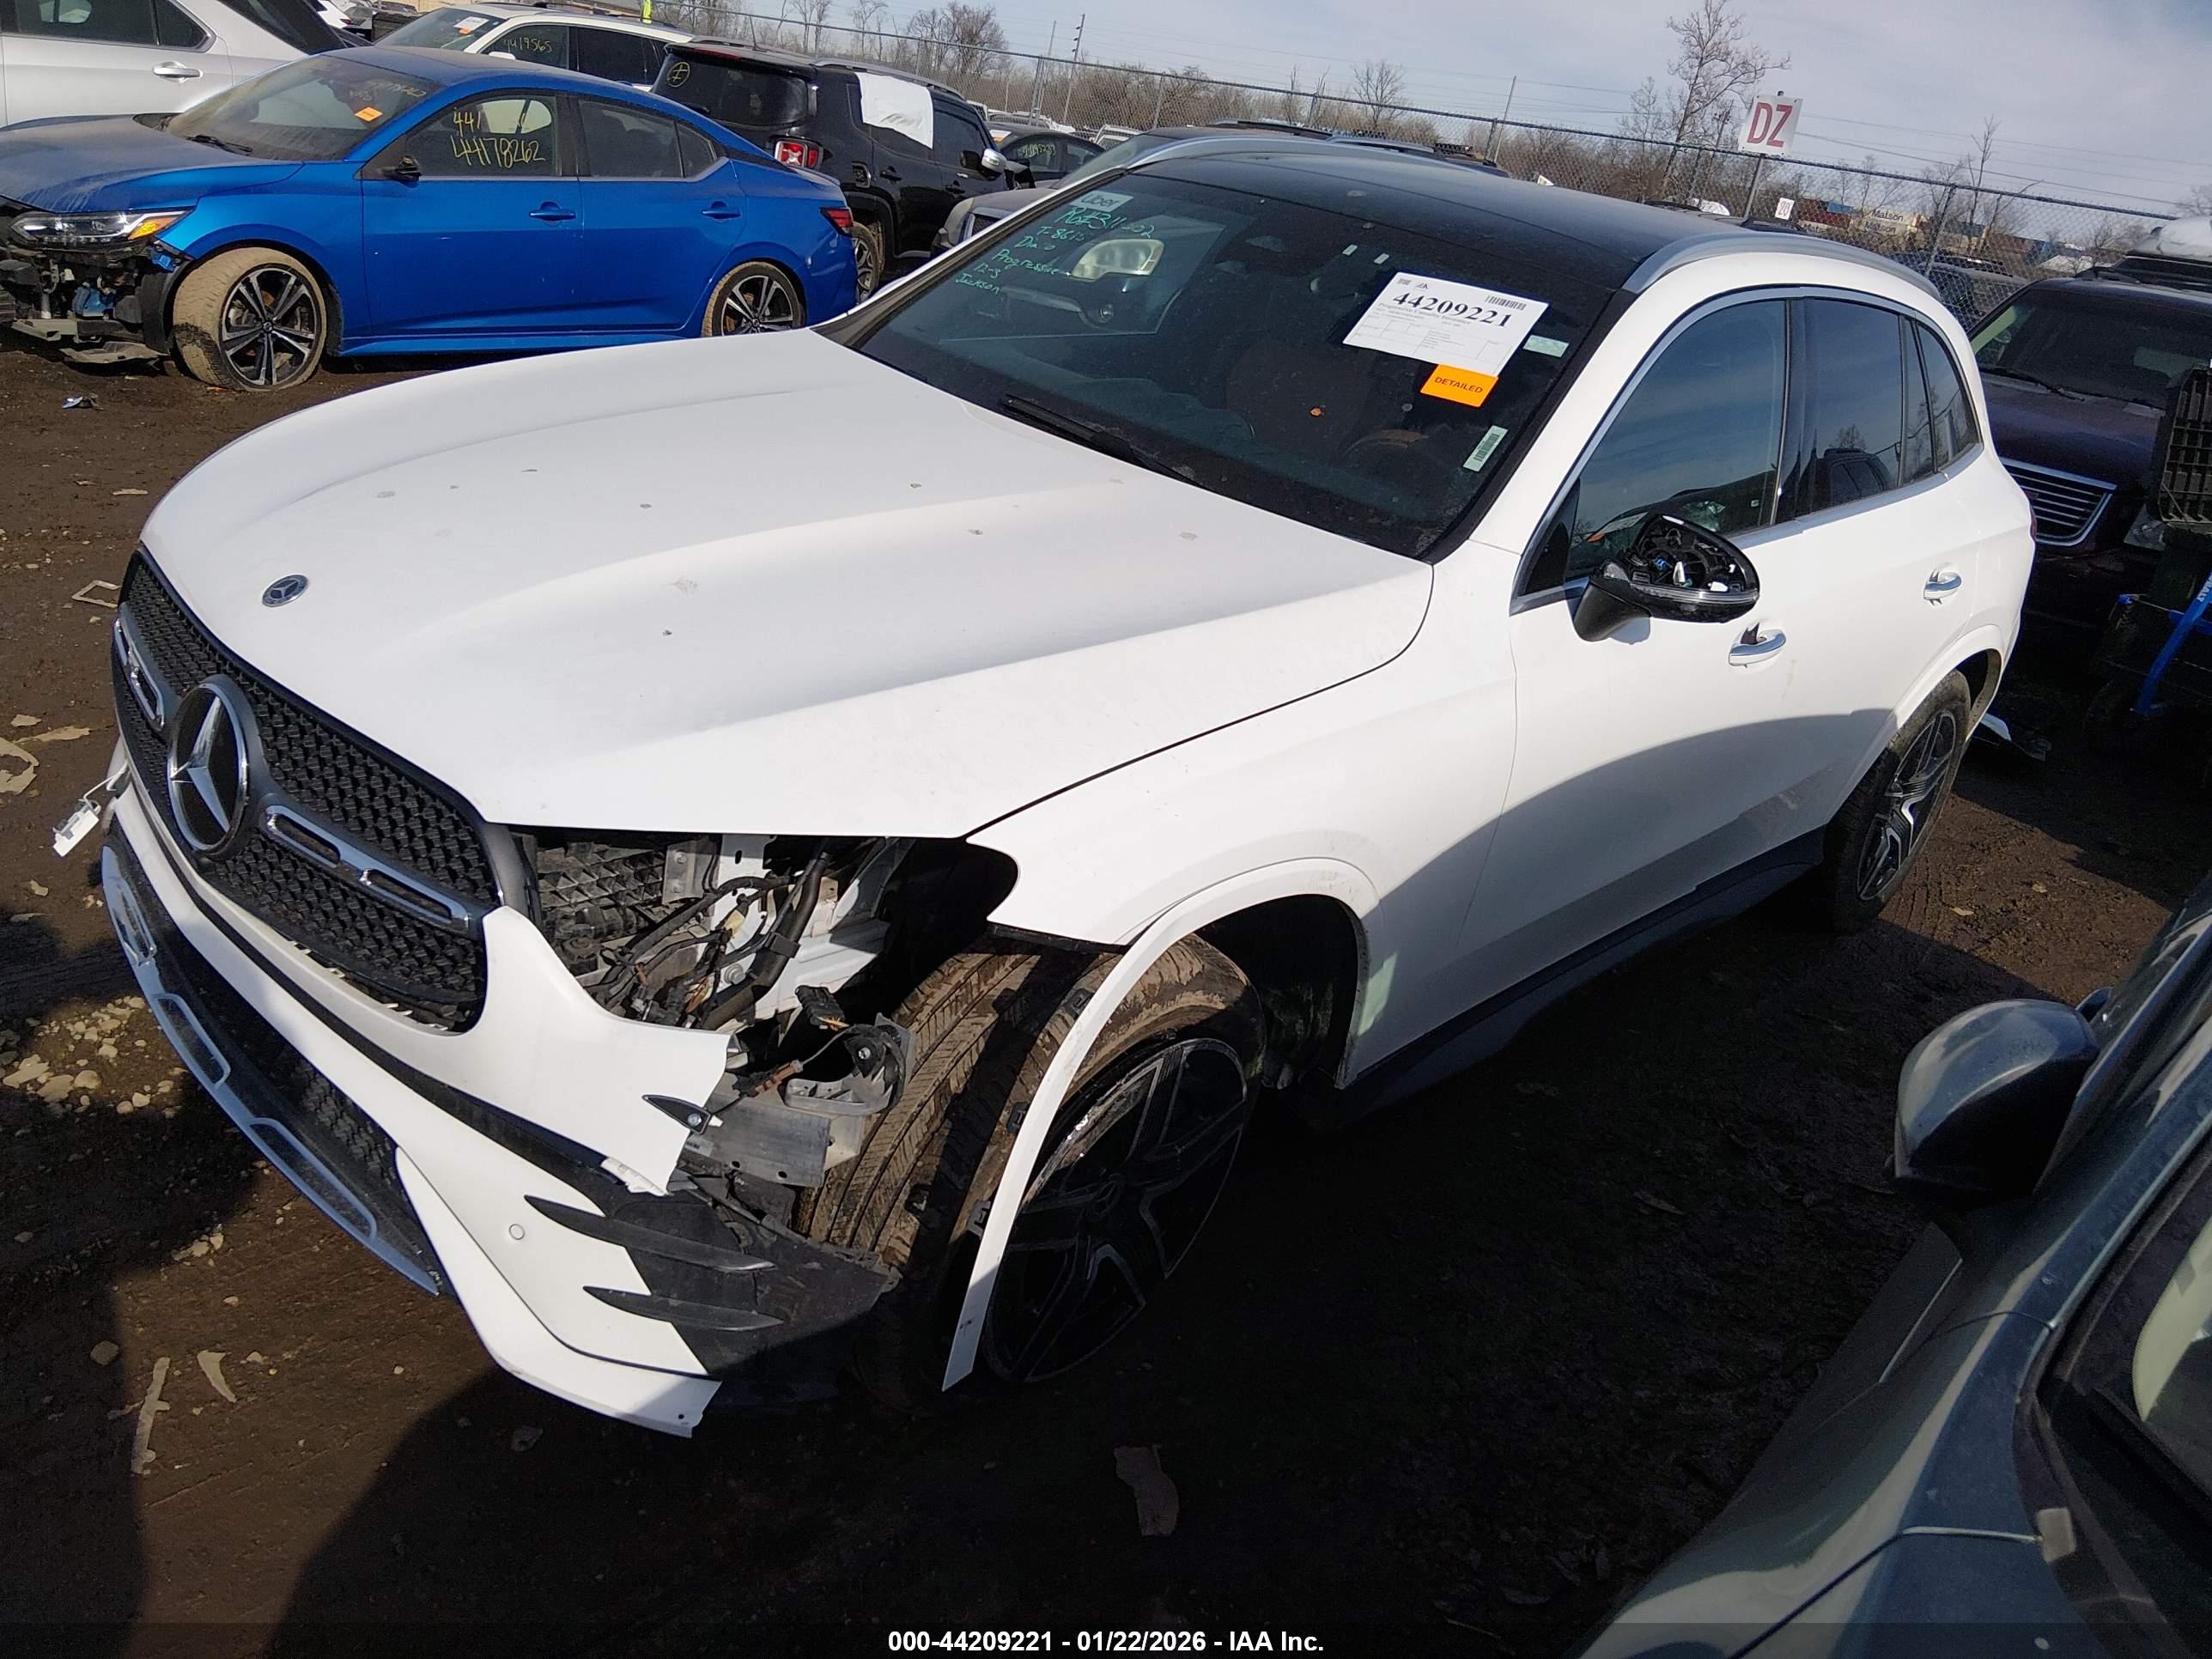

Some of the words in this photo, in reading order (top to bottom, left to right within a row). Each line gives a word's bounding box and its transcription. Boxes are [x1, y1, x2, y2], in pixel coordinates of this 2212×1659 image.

[1747, 101, 1793, 148] DZ
[450, 136, 546, 168] 44178262
[1393, 293, 1511, 327] 44209221
[1435, 376, 1483, 393] DETAILED
